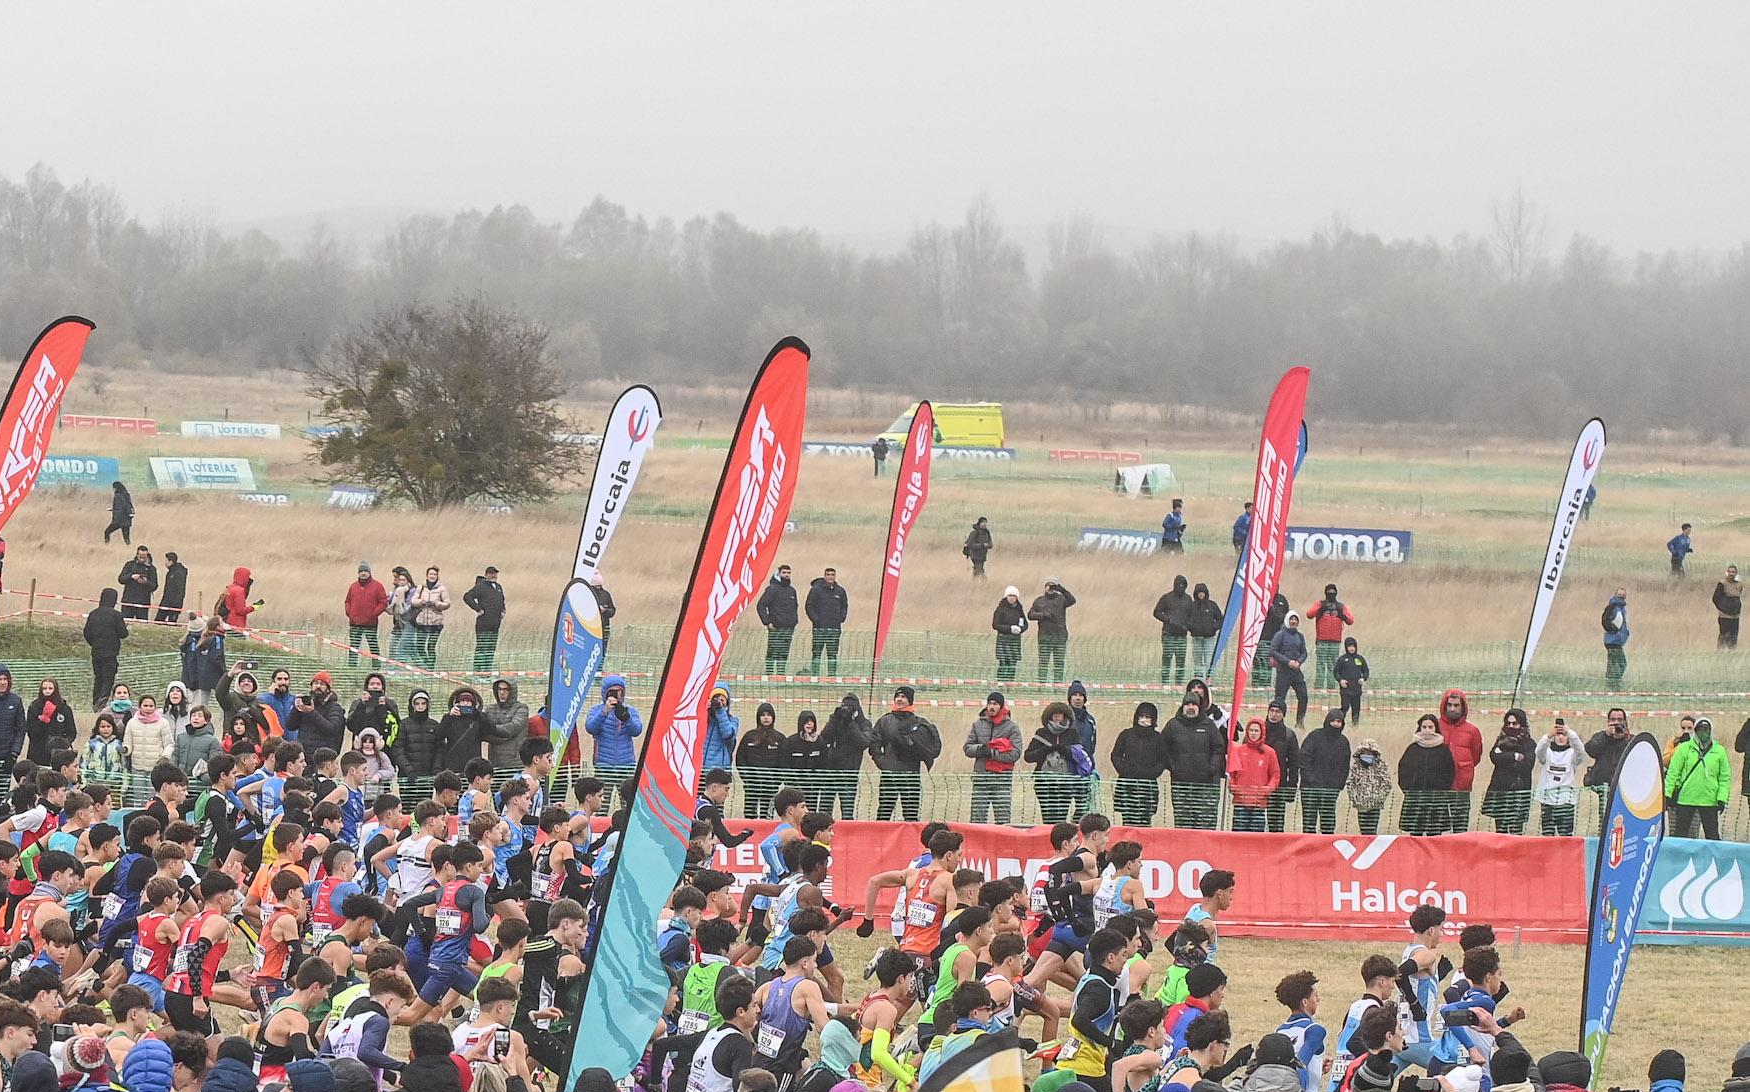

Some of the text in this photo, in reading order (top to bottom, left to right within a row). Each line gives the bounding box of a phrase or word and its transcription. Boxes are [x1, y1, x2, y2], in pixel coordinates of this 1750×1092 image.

[0, 353, 57, 495] RFEA
[43, 459, 99, 473] ONDO
[188, 462, 238, 474] LOTERÍAS
[582, 458, 633, 569] Ibercaja
[703, 403, 776, 655] RFEA
[886, 470, 923, 578] Ibercaja
[1247, 437, 1277, 600] RFEA
[1544, 486, 1584, 591] Ibercaja
[1331, 880, 1467, 915] Halcón
